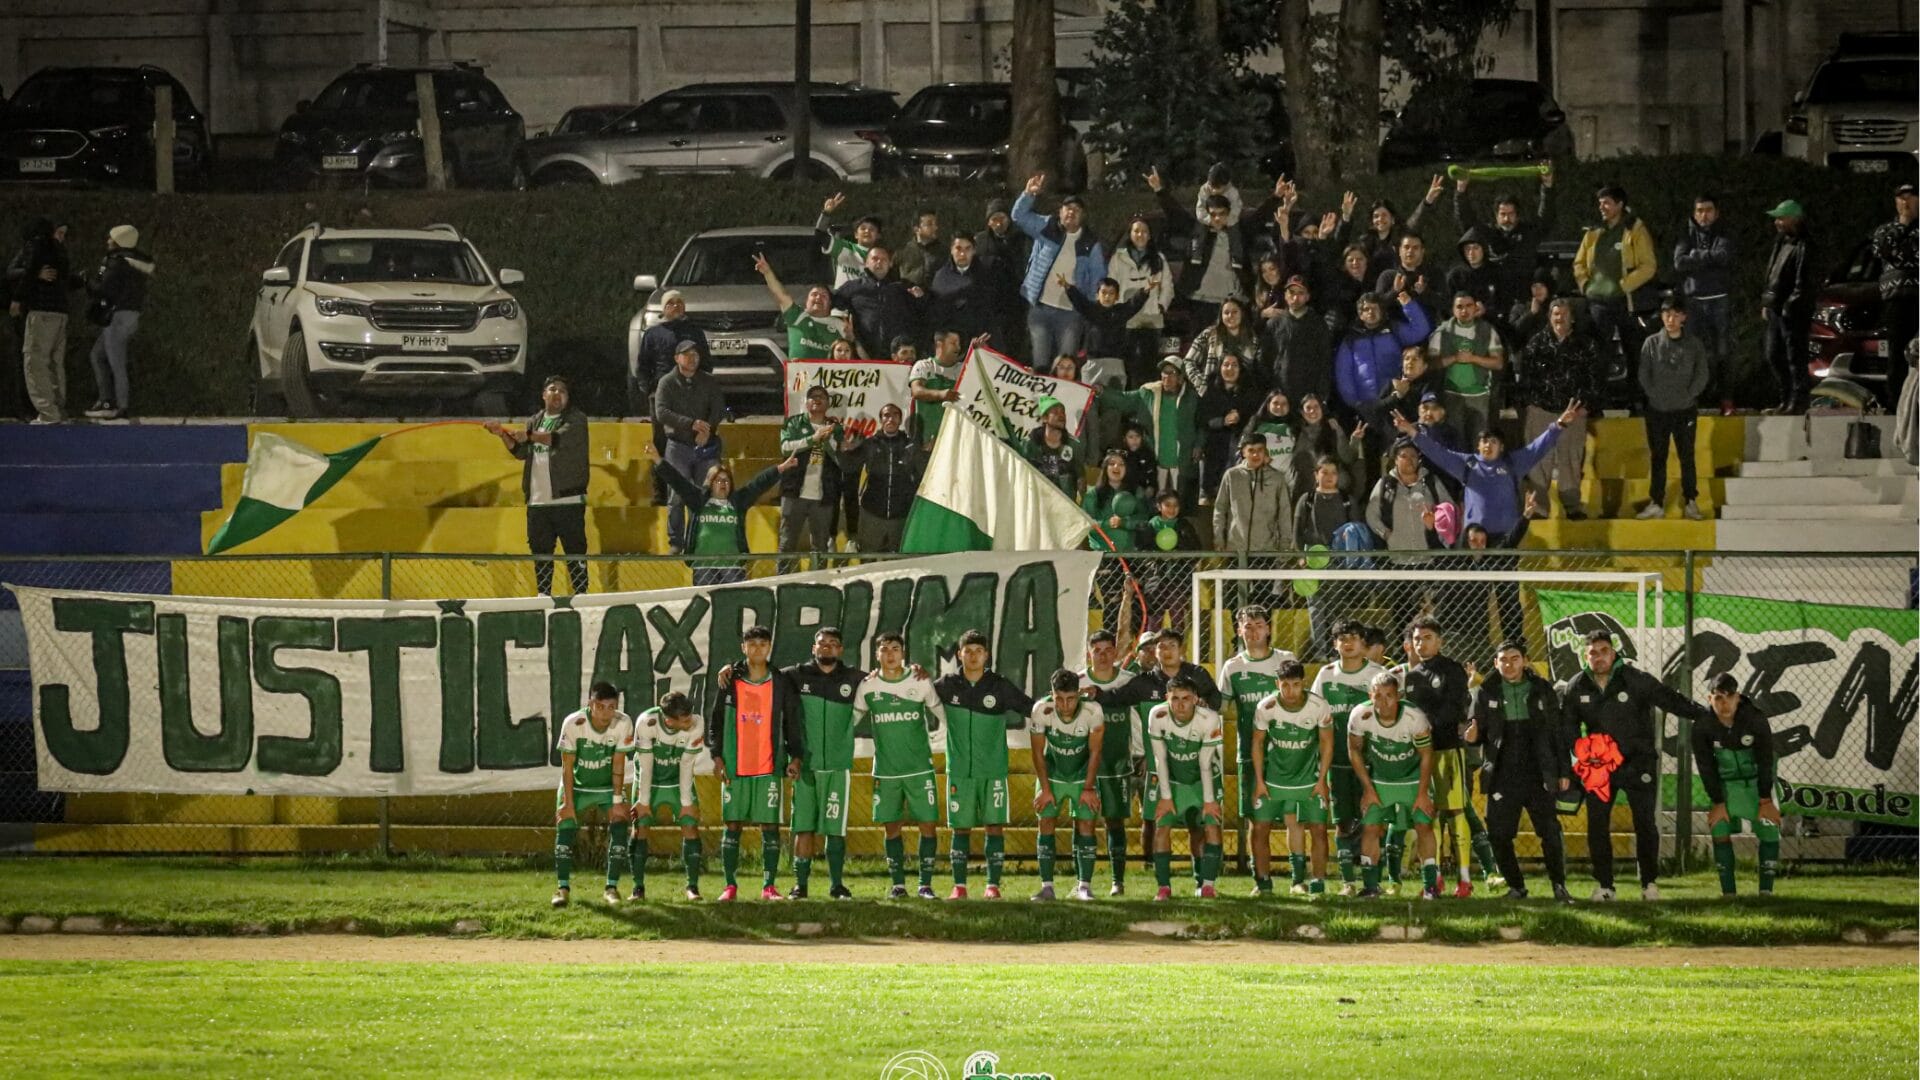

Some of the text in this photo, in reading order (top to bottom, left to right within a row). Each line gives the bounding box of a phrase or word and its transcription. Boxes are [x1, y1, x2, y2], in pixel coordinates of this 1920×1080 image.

[800, 337, 831, 351] DIMAC
[847, 391, 866, 408] LA
[1269, 446, 1292, 457] MAC
[39, 596, 656, 777] JUSTICIA
[1239, 690, 1272, 703] DIMA
[1329, 703, 1354, 714] DIMA
[874, 711, 920, 724] DIMACO
[1103, 712, 1126, 723] ACO
[577, 756, 612, 770] DIMAC
[1170, 751, 1199, 761] MAC
[926, 789, 935, 806] 6
[992, 791, 1005, 809] 27
[825, 802, 840, 820] 29
